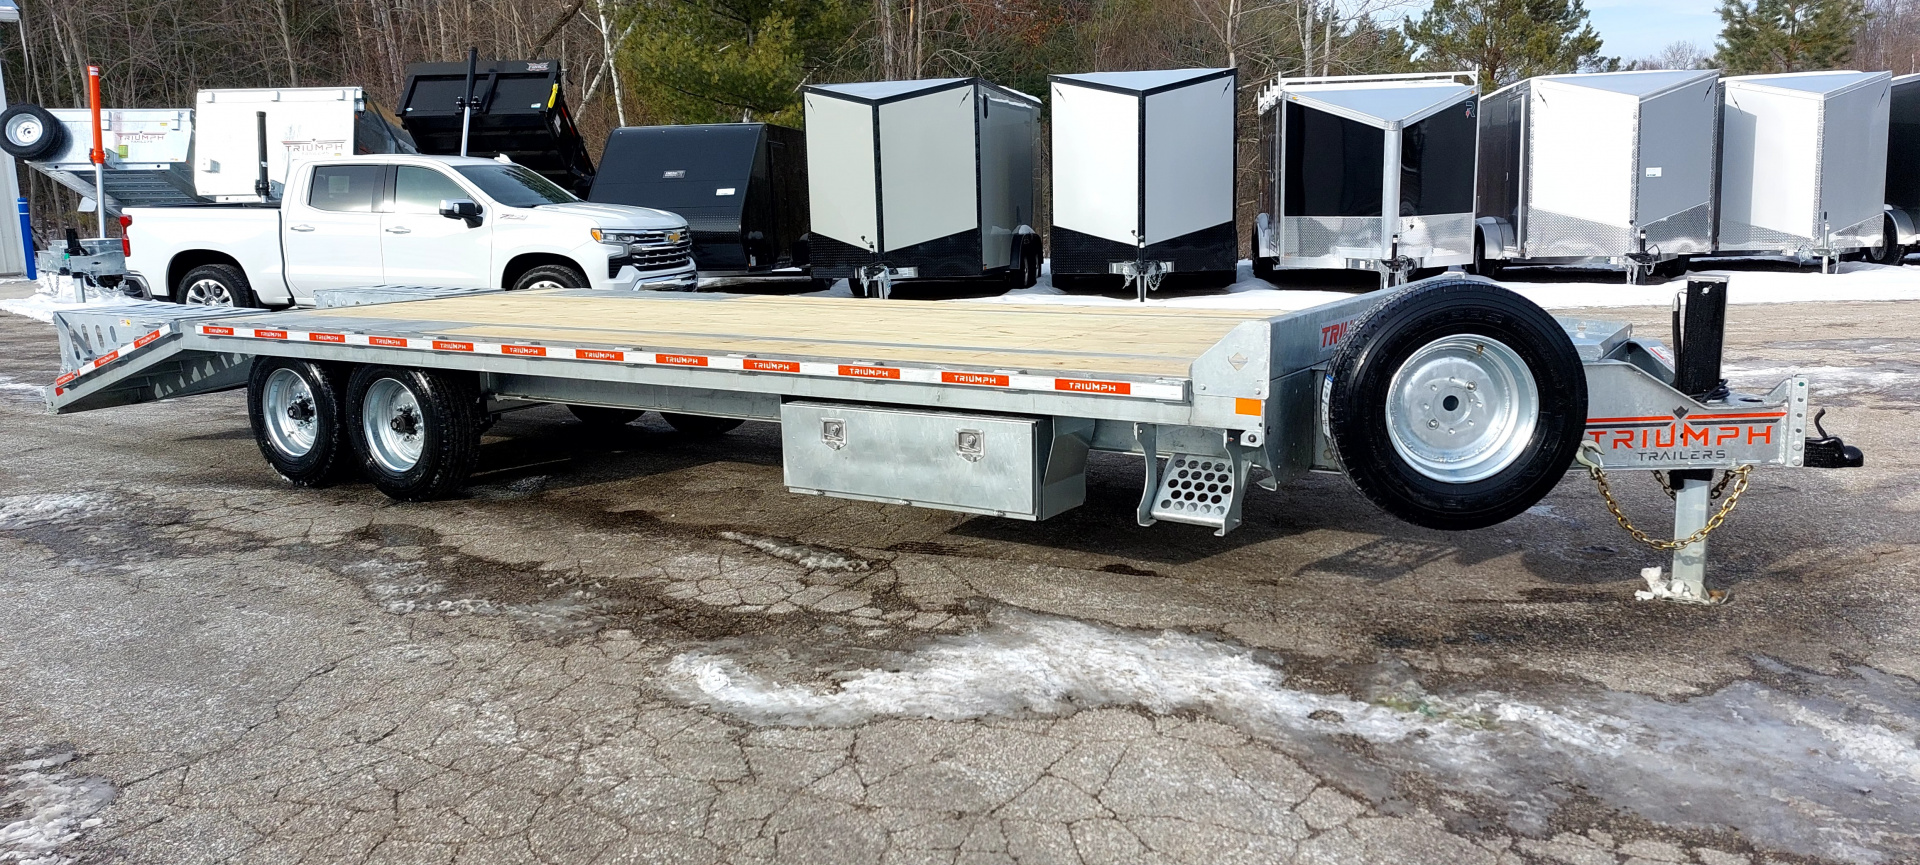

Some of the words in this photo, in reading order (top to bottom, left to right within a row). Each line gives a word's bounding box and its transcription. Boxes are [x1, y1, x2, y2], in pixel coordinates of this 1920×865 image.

[285, 143, 344, 152] TRIUMPH
[375, 338, 401, 346] TRIUMPH
[440, 342, 467, 350] TRIUMPH
[509, 346, 538, 355] TRIUMPH
[584, 350, 615, 360] TRIUMPH
[665, 355, 699, 365] TRIUMPH
[753, 361, 790, 371] TRIUMPH
[849, 367, 889, 378] TRIUMPH
[953, 374, 997, 385] TRIUMPH
[1068, 381, 1117, 393] TRIUMPH
[1587, 422, 1774, 450] TRIUMPH
[1637, 449, 1727, 462] TRAILERS
